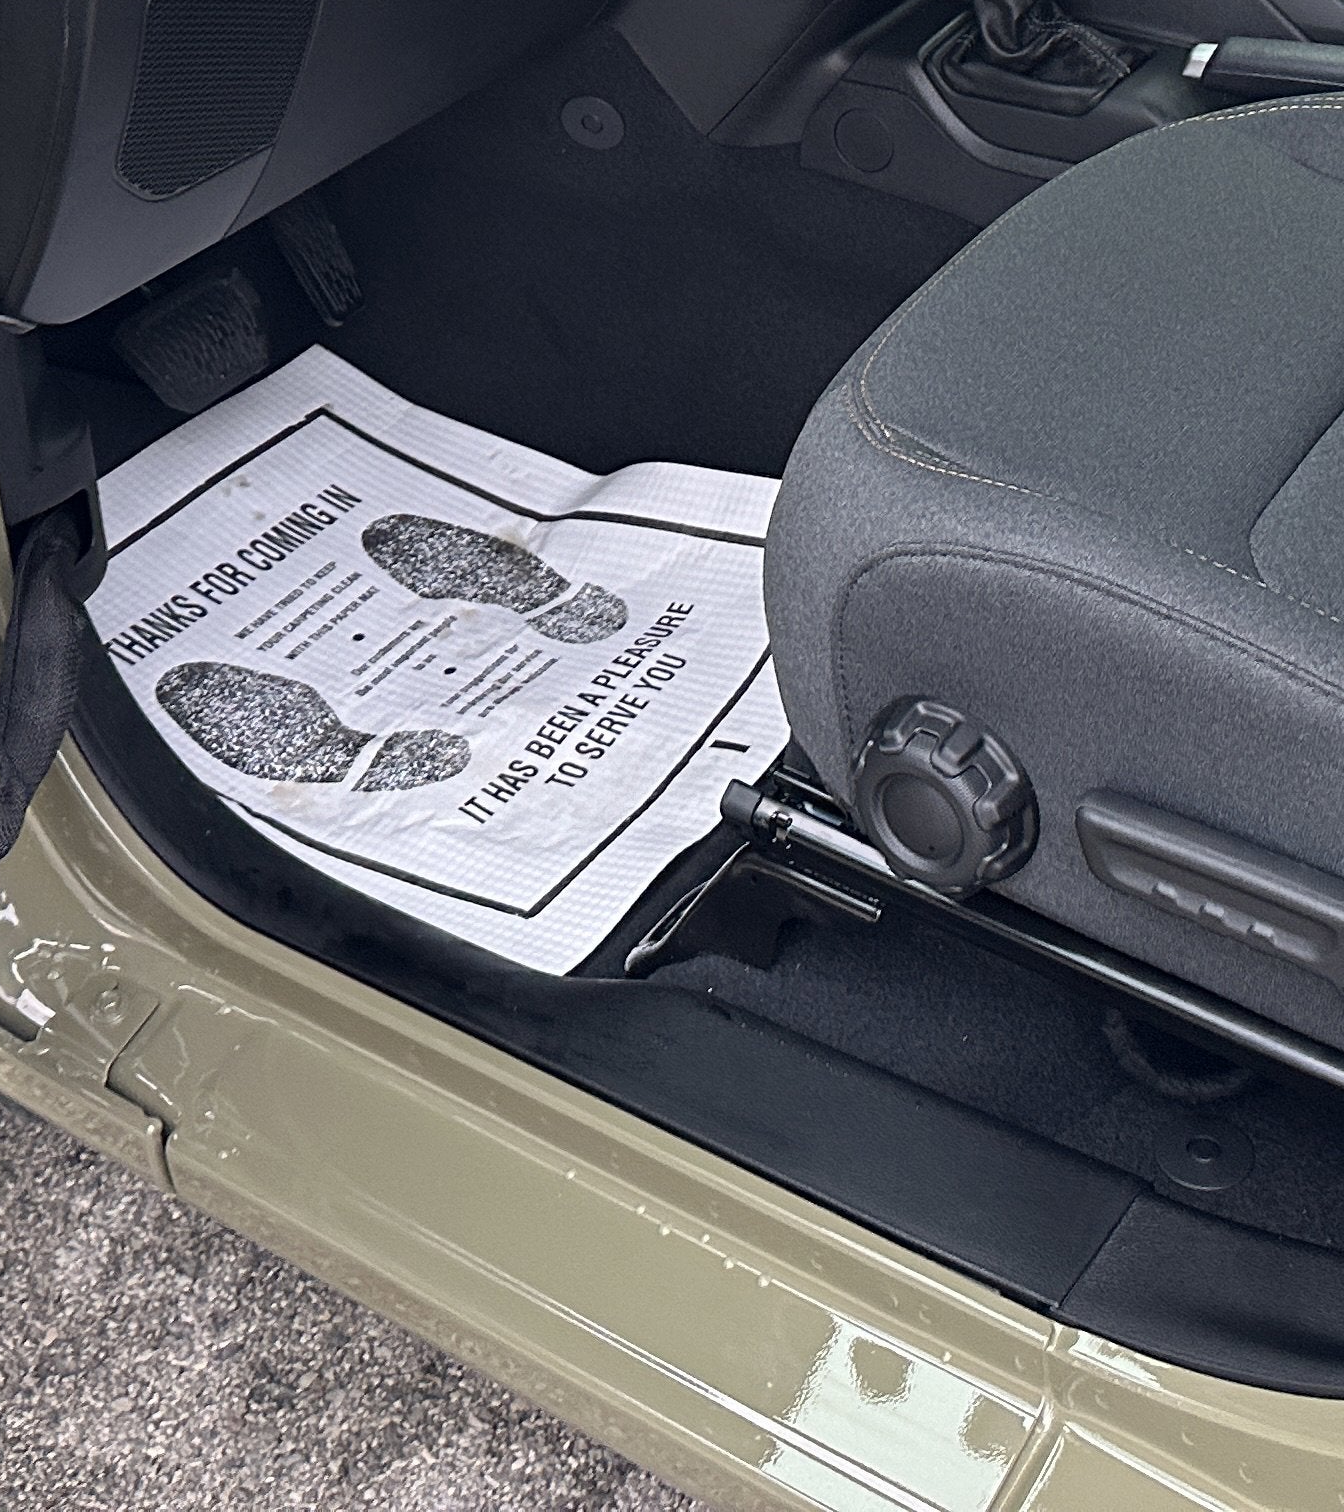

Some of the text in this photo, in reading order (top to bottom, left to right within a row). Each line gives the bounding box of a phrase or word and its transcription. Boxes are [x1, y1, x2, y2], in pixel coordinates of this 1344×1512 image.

[106, 483, 363, 666] THANKS FOR COMING IN
[234, 560, 336, 639] WE HAVE TRIED TO KEEP
[256, 571, 363, 651] YOUR CARPETING CLEAN
[284, 585, 381, 660] WITH THIS PAPER MAT
[458, 601, 695, 824] IT HAS BEEN A PLEASURE
[544, 653, 687, 787] TO SERVE YOU
